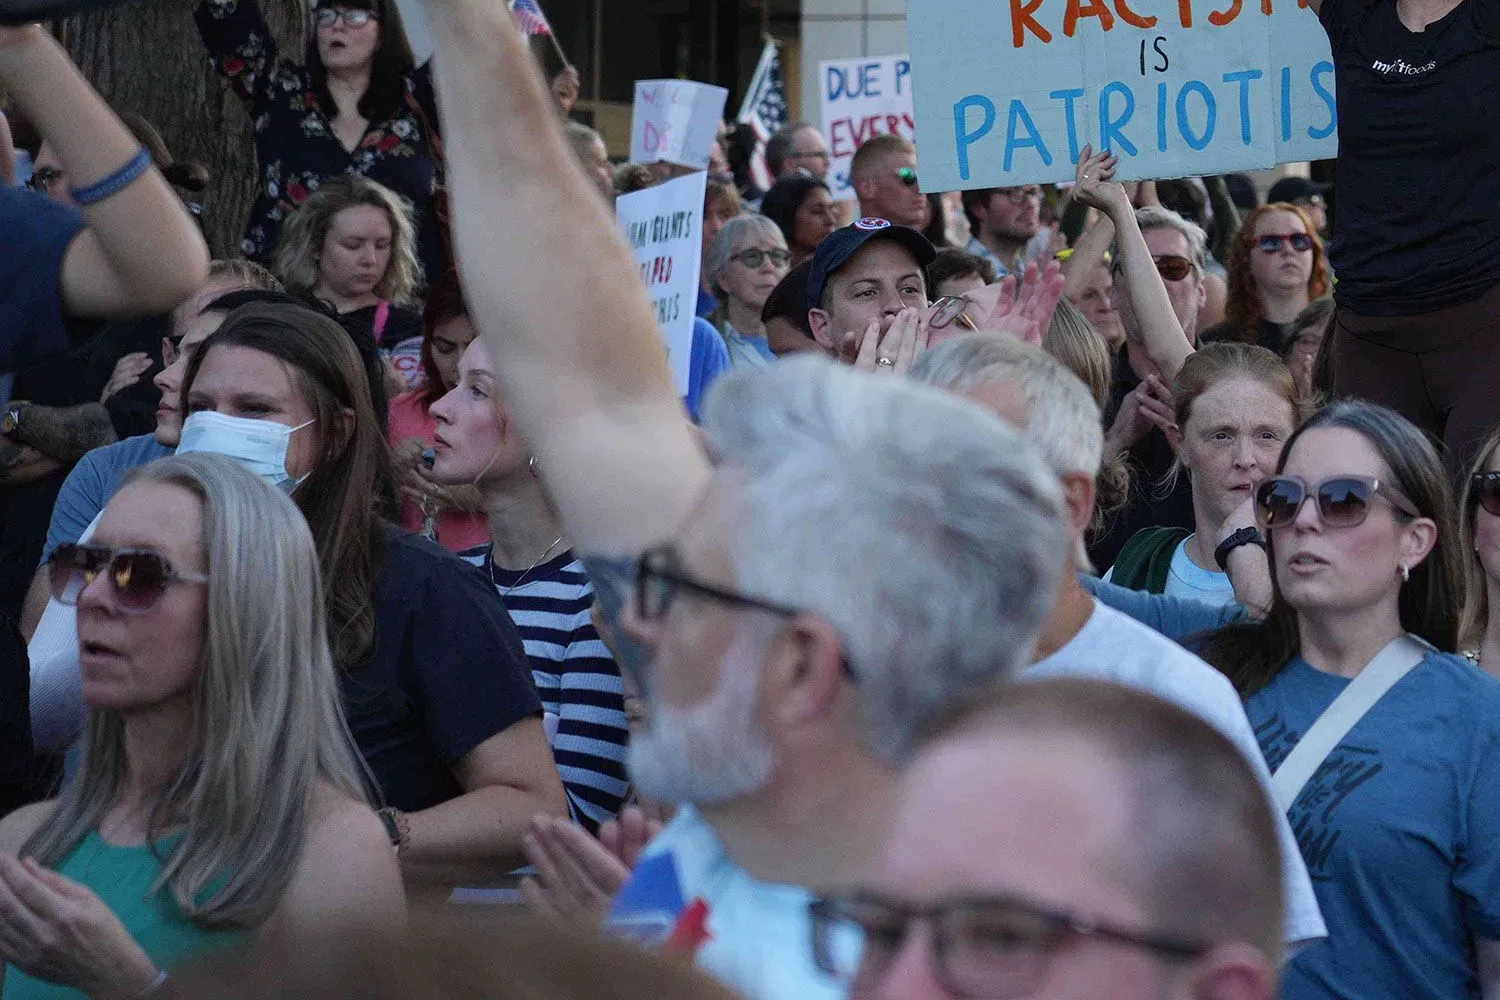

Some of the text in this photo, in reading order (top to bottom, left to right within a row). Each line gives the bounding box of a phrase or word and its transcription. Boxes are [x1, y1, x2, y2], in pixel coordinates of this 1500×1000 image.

[1140, 36, 1169, 76] IS
[828, 61, 911, 100] DUE P
[953, 61, 1338, 180] PATRIOTIS
